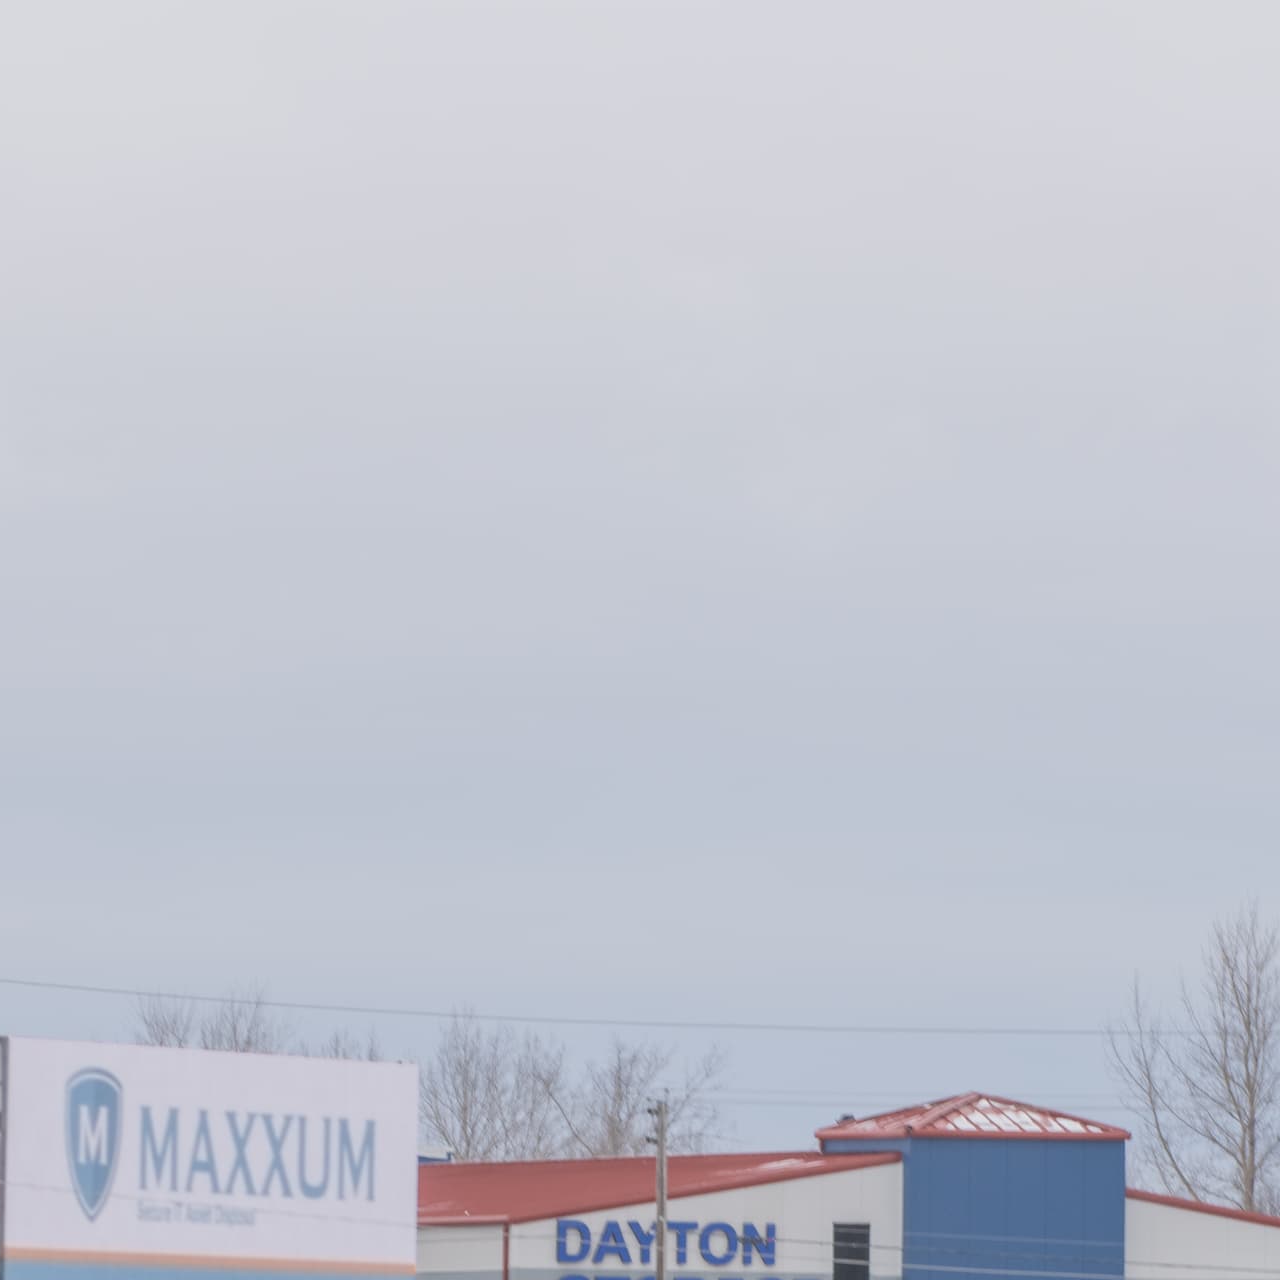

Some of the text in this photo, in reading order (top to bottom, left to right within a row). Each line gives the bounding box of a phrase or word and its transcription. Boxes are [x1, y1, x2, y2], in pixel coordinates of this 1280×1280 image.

[78, 1104, 109, 1166] M
[138, 1105, 376, 1202] MAXXUM
[556, 1219, 776, 1265] DAYTON
